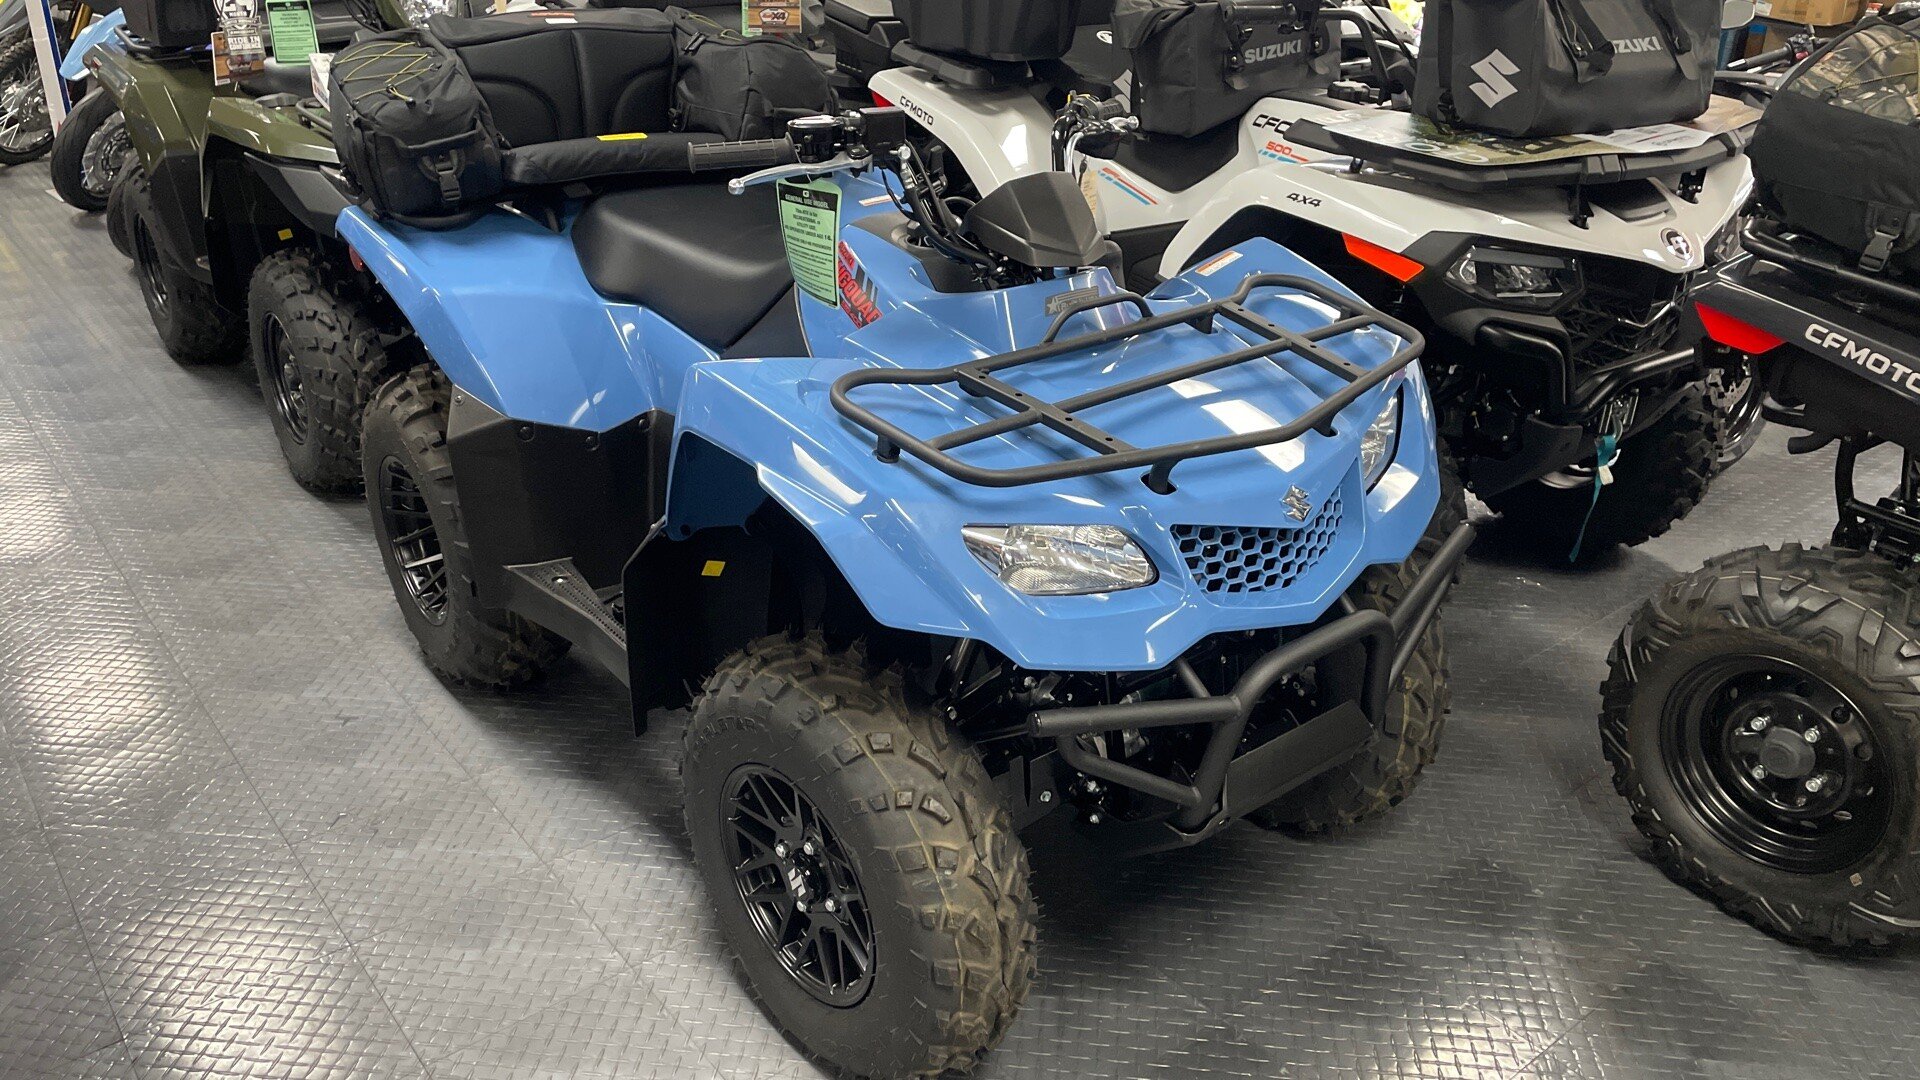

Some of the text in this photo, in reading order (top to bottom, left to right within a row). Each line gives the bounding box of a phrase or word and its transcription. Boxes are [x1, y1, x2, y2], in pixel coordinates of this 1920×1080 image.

[1244, 39, 1302, 64] SUZUKI
[1611, 36, 1661, 54] ZUKI
[899, 95, 934, 126] CFMOTO
[1265, 140, 1292, 156] 500
[1804, 323, 1920, 394] CFMOTO
